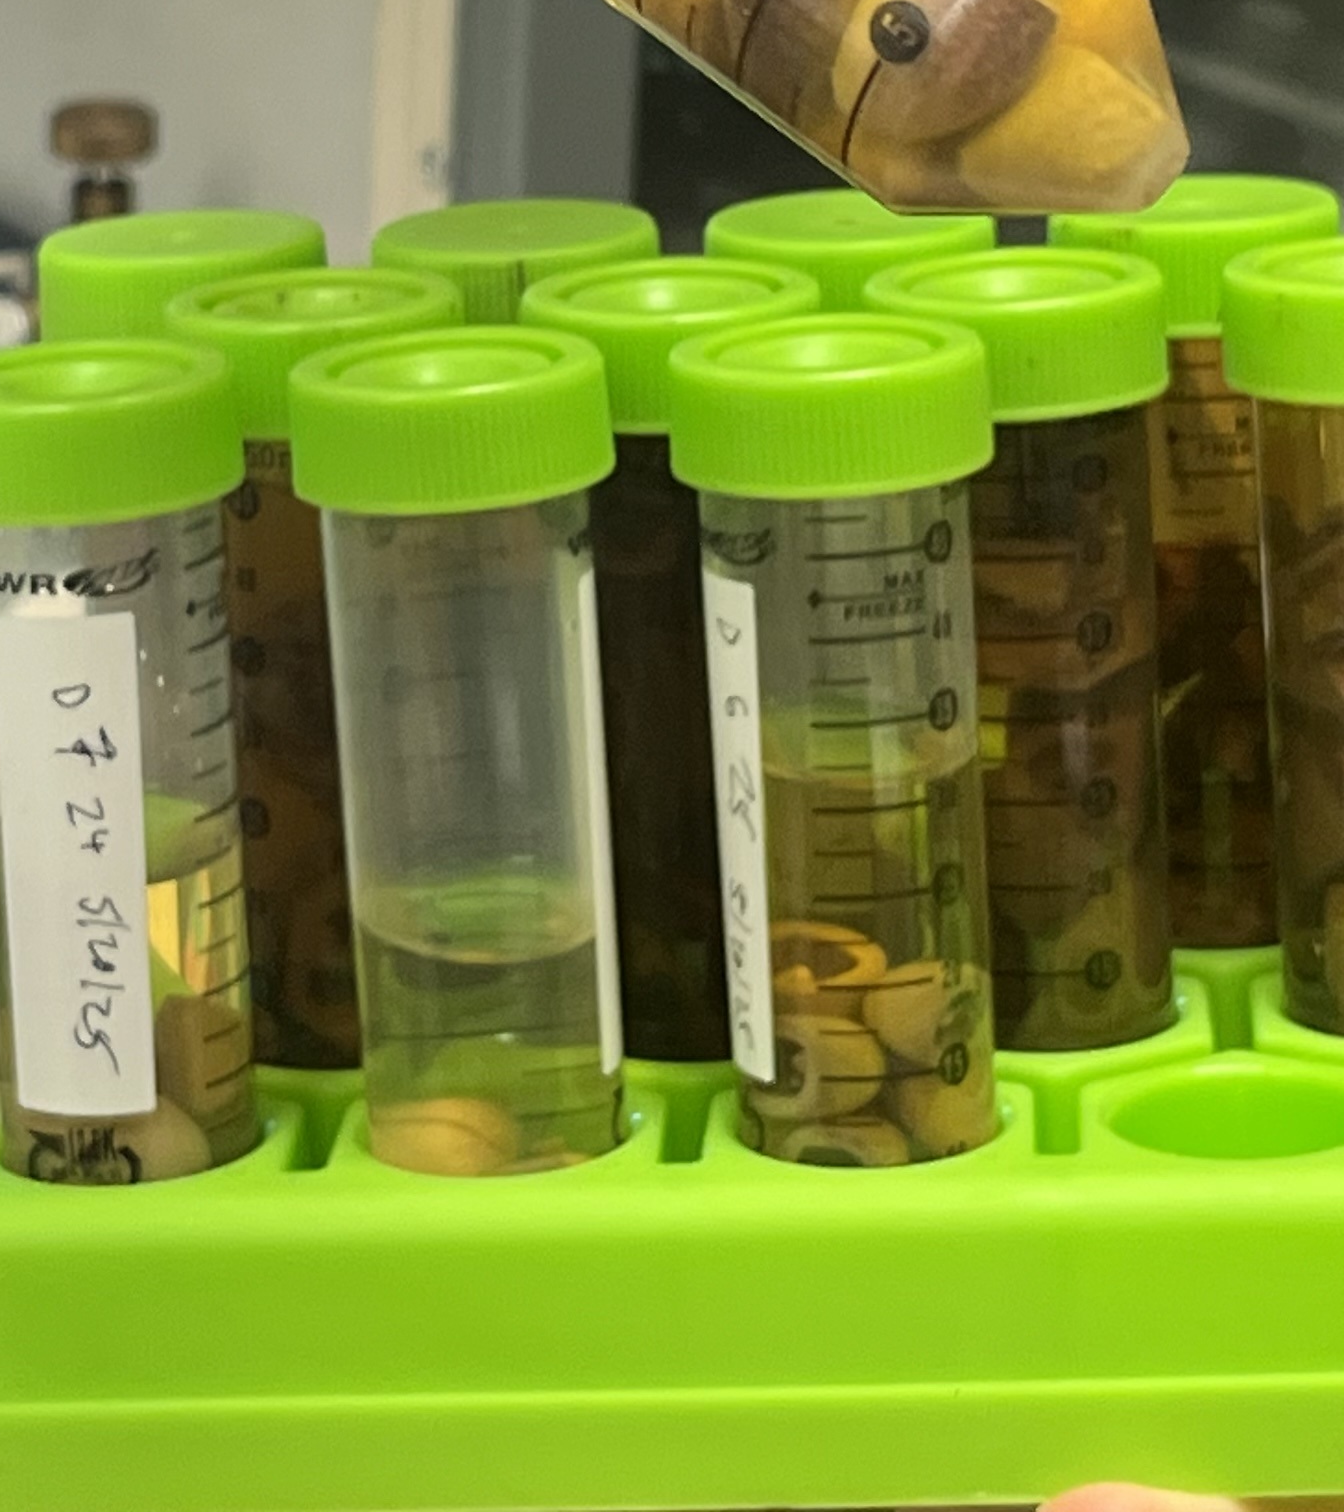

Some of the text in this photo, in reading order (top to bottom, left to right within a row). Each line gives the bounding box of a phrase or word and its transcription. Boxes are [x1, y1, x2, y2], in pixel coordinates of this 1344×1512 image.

[882, 11, 919, 48] 5
[884, 569, 926, 589] MAX
[843, 598, 925, 622] FREEZE
[51, 682, 92, 710] D
[64, 796, 112, 856] 24
